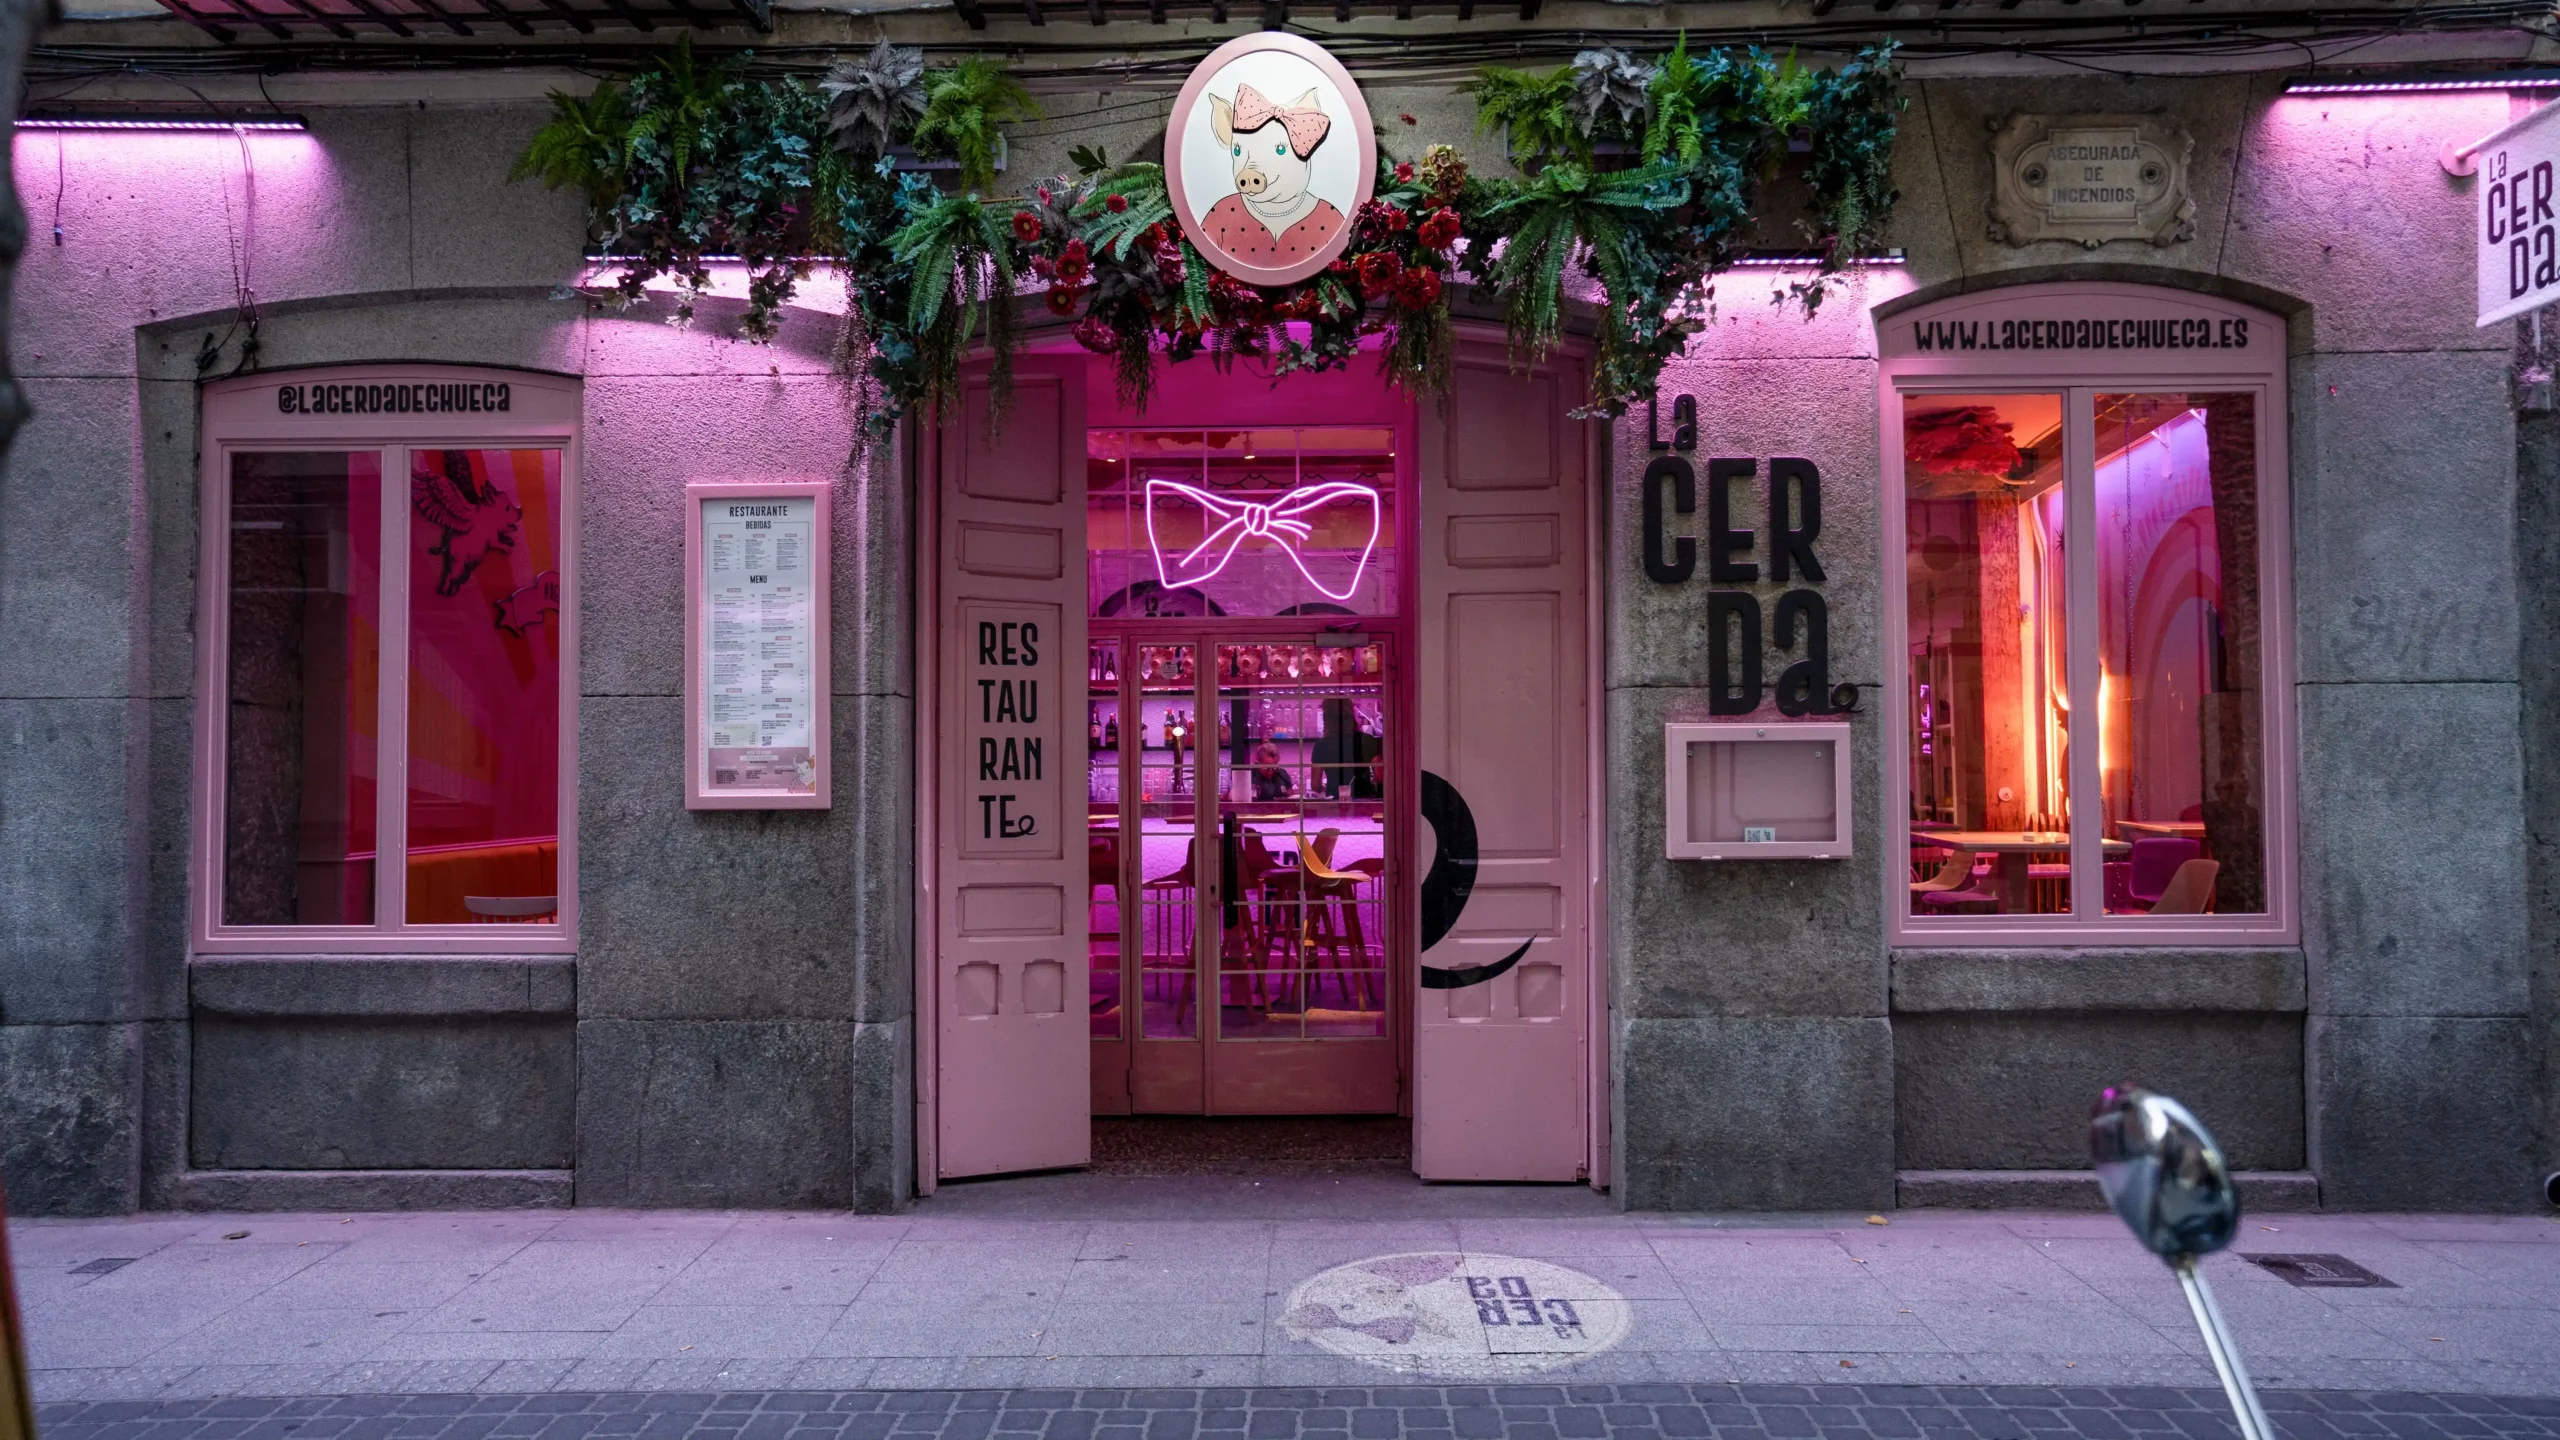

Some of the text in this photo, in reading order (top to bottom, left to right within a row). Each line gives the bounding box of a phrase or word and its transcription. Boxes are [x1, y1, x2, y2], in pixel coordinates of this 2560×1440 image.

[2045, 146, 2141, 161] ASEGURADA
[2084, 167, 2105, 182] DE
[2487, 160, 2555, 245] CER
[729, 505, 788, 518] RESTAURANTE
[745, 520, 772, 530] BEBIDAS
[1642, 456, 1828, 584] CER
[749, 575, 768, 584] MENU
[978, 621, 1038, 667] RES
[978, 679, 1038, 724] TAU
[979, 737, 1042, 781] RAN
